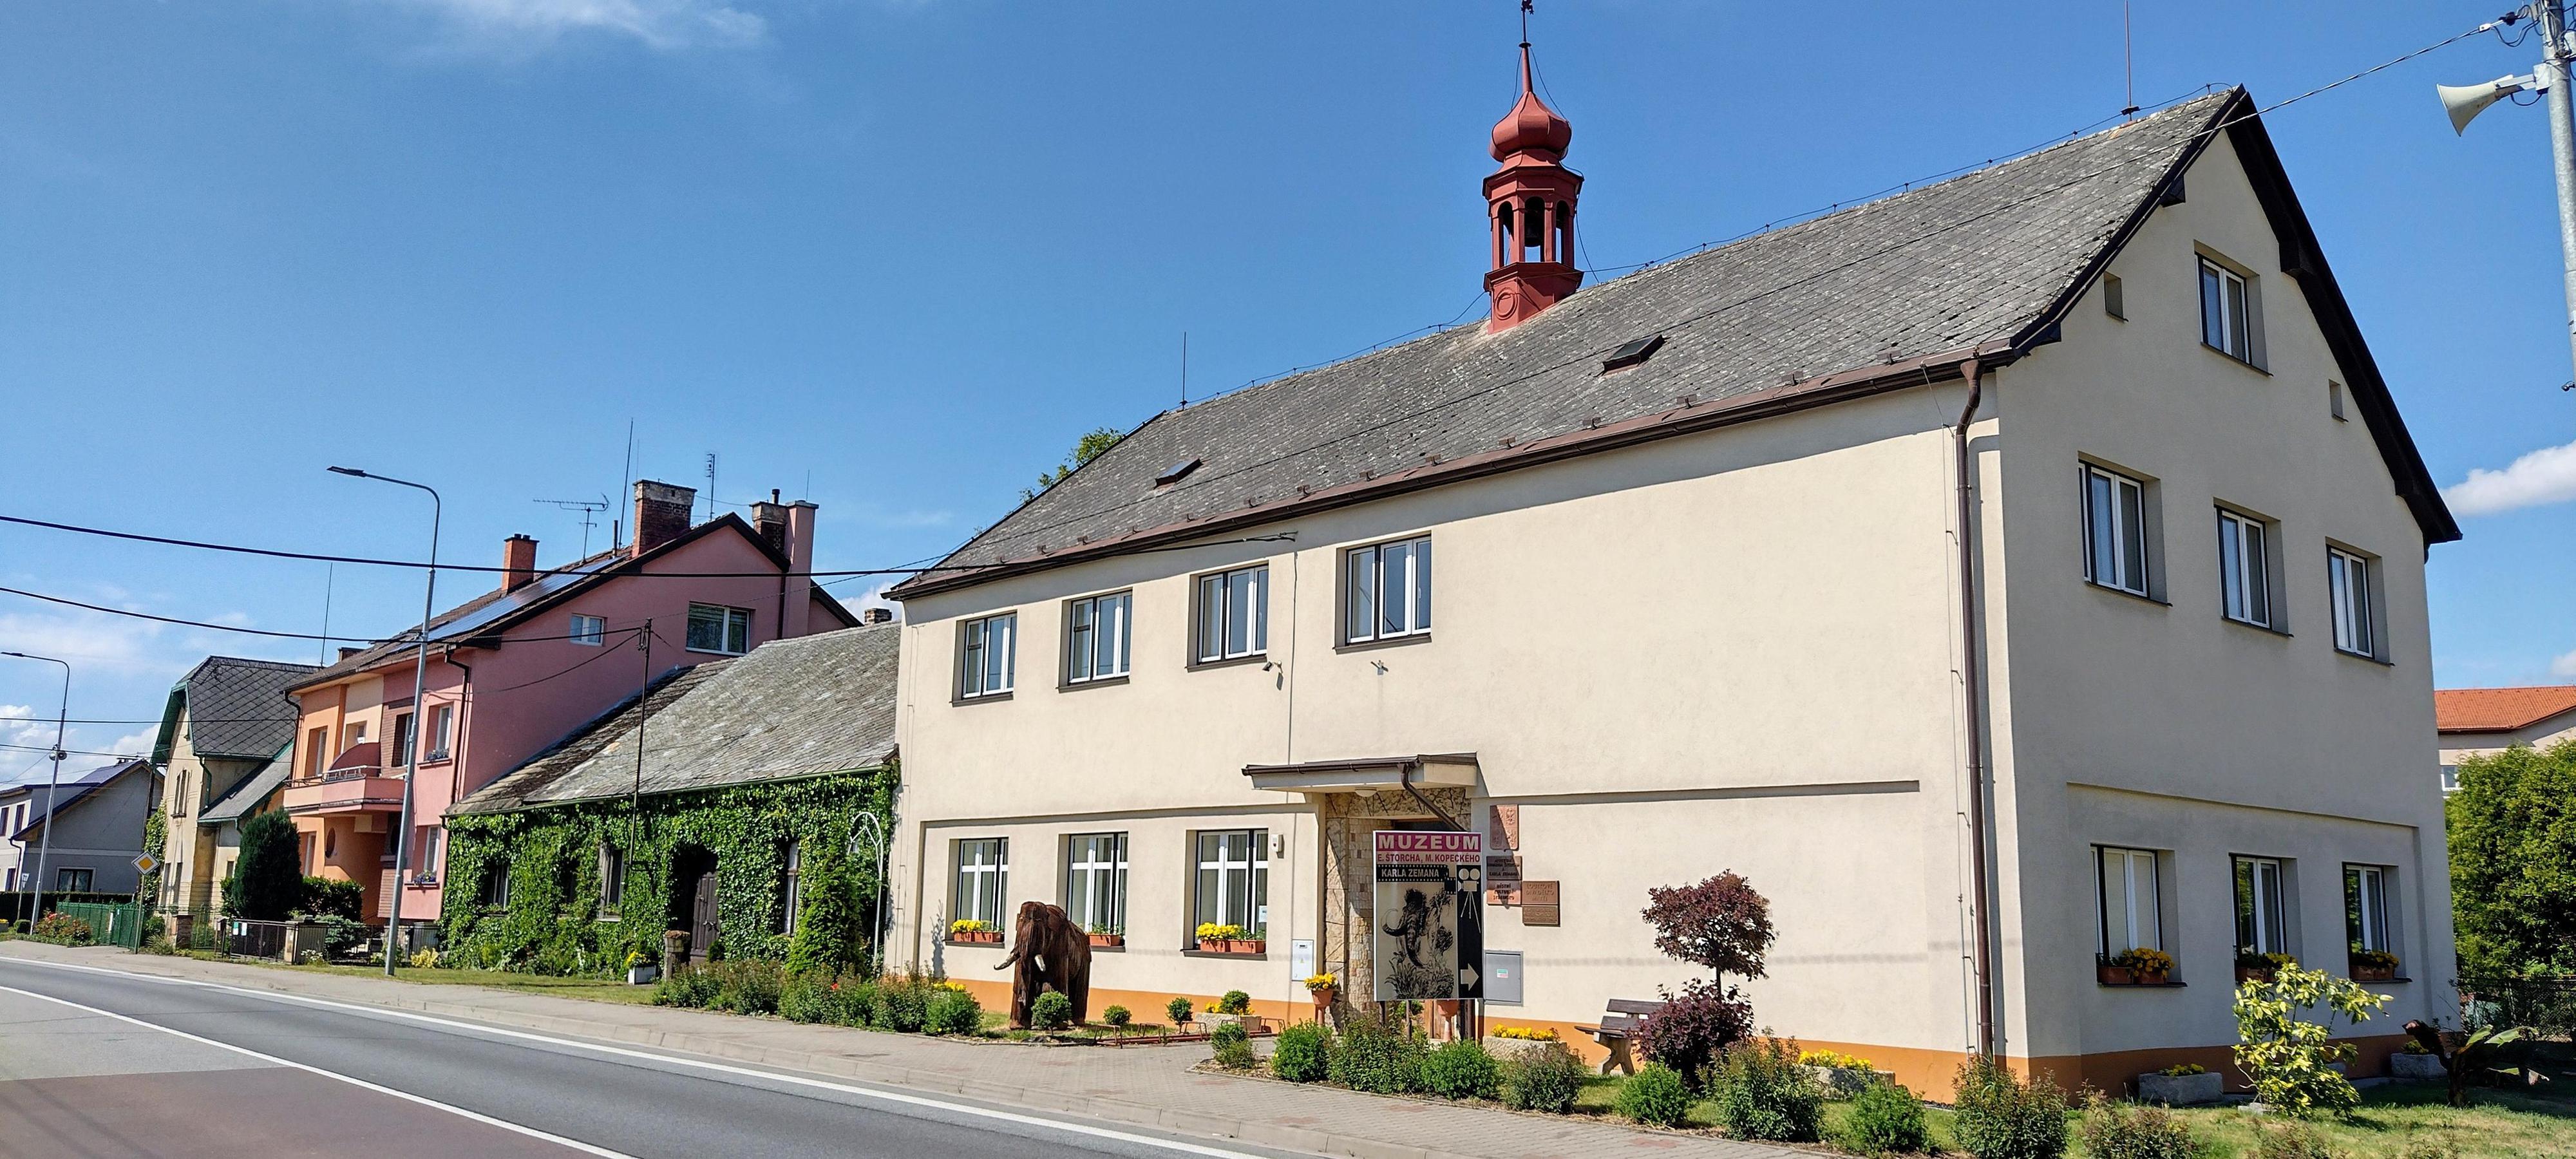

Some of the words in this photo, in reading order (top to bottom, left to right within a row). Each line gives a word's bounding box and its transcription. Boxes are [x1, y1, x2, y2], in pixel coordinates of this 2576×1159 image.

[1378, 835, 1479, 850] MUZEUM
[1385, 852, 1423, 863] ŠTORCHA,
[1435, 853, 1480, 863] KOPECKÉHO
[1381, 869, 1406, 877] KARLA
[1408, 869, 1439, 877] ZEMANA
